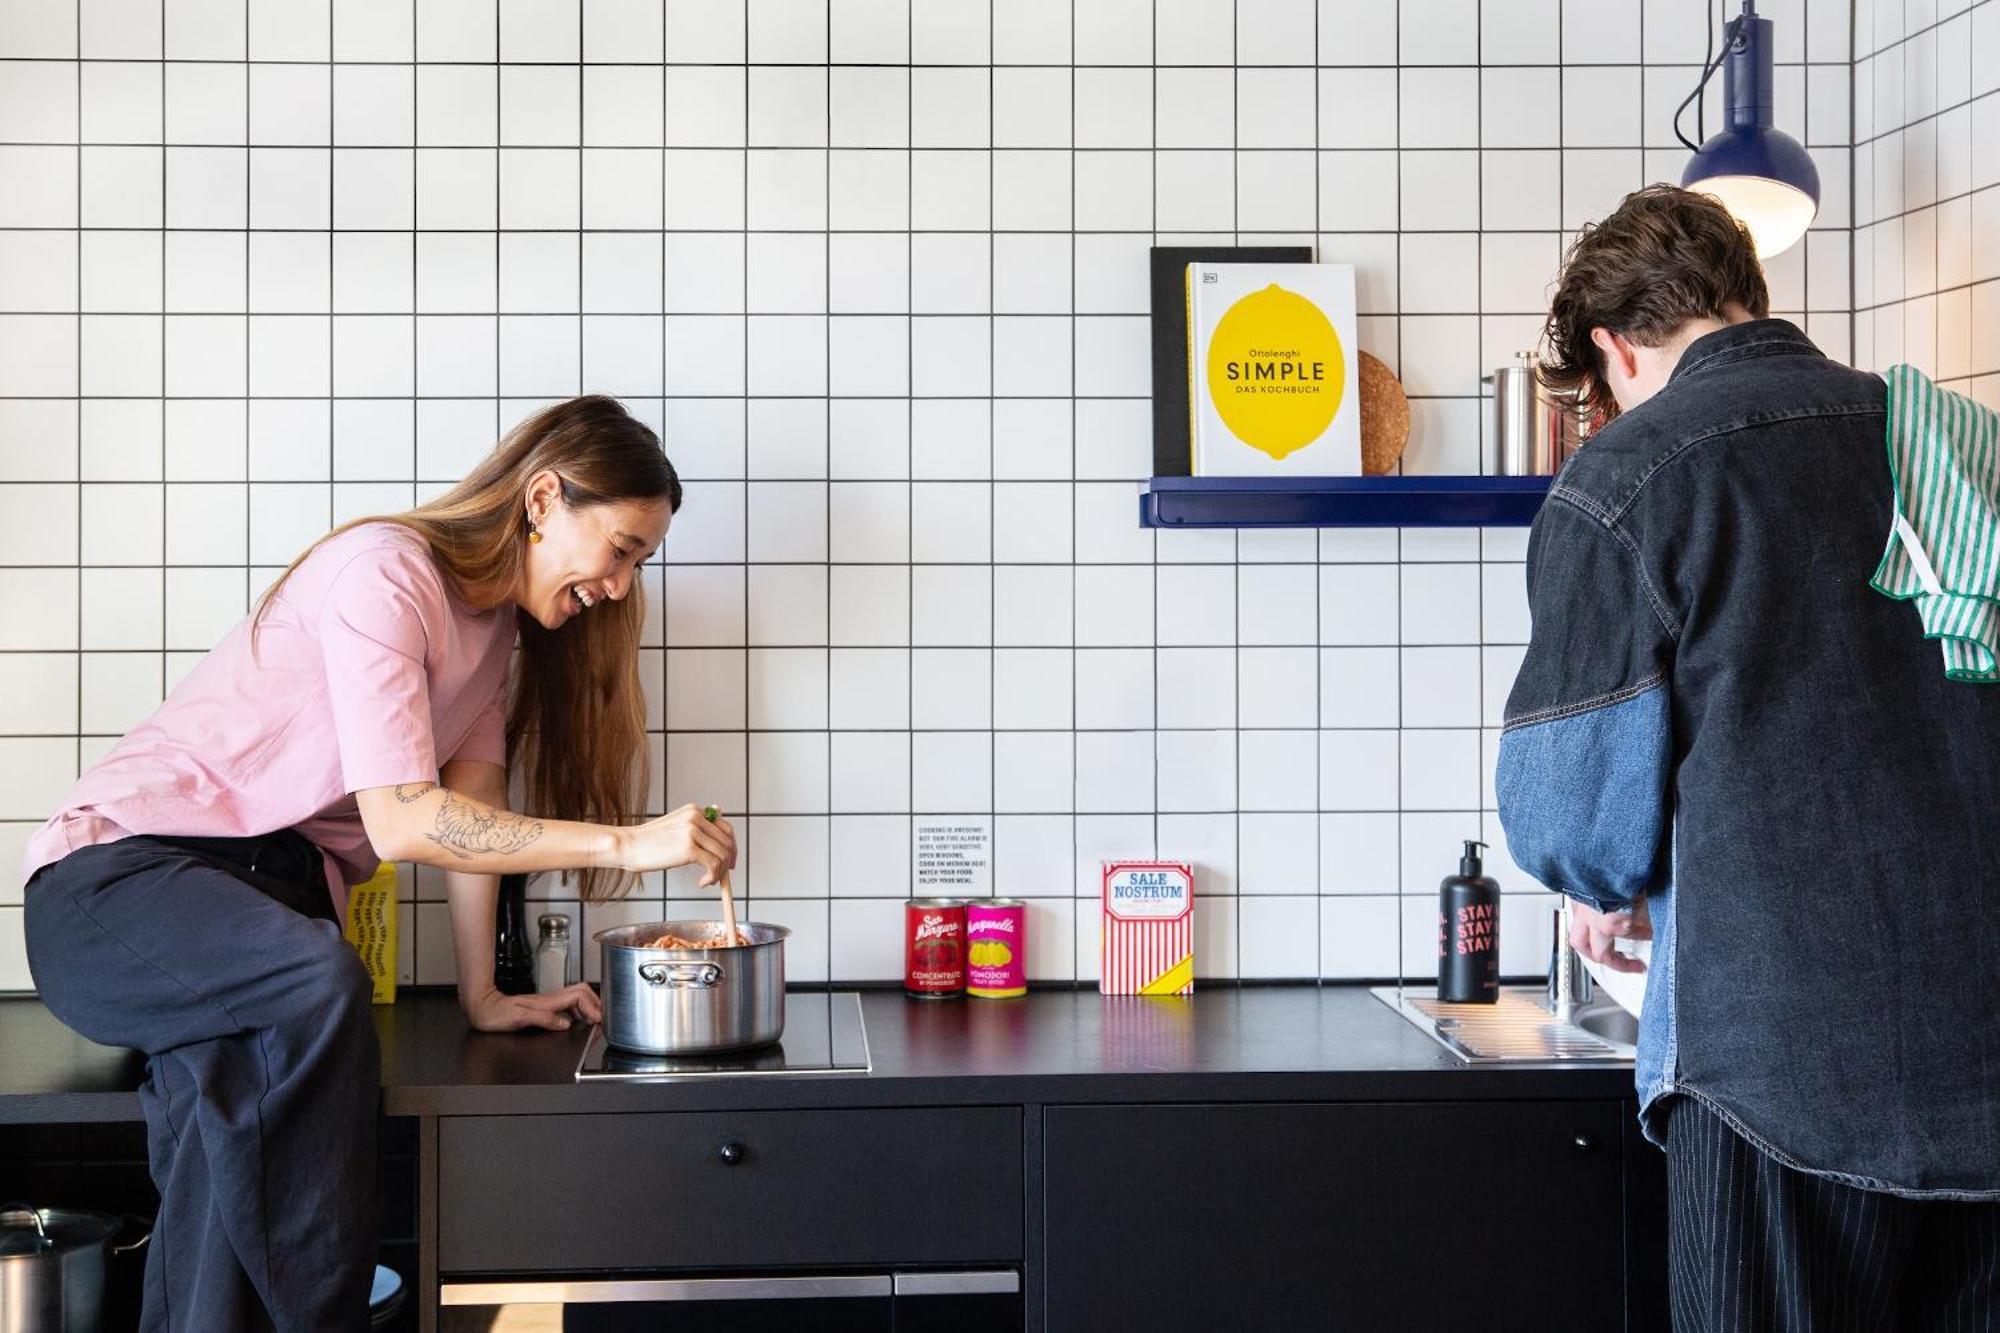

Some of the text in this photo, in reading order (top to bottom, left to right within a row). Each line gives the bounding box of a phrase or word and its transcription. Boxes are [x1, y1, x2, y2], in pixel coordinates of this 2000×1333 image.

[1249, 349, 1300, 359] Ottolenghi
[1226, 362, 1324, 381] SIMPLE
[1236, 386, 1320, 394] DAS KOCHBUCH
[1130, 873, 1167, 885] SALE
[1114, 886, 1182, 898] NOSTRUM
[1457, 904, 1493, 922] STAY
[1457, 920, 1492, 939] STAY
[1456, 937, 1491, 955] STAY
